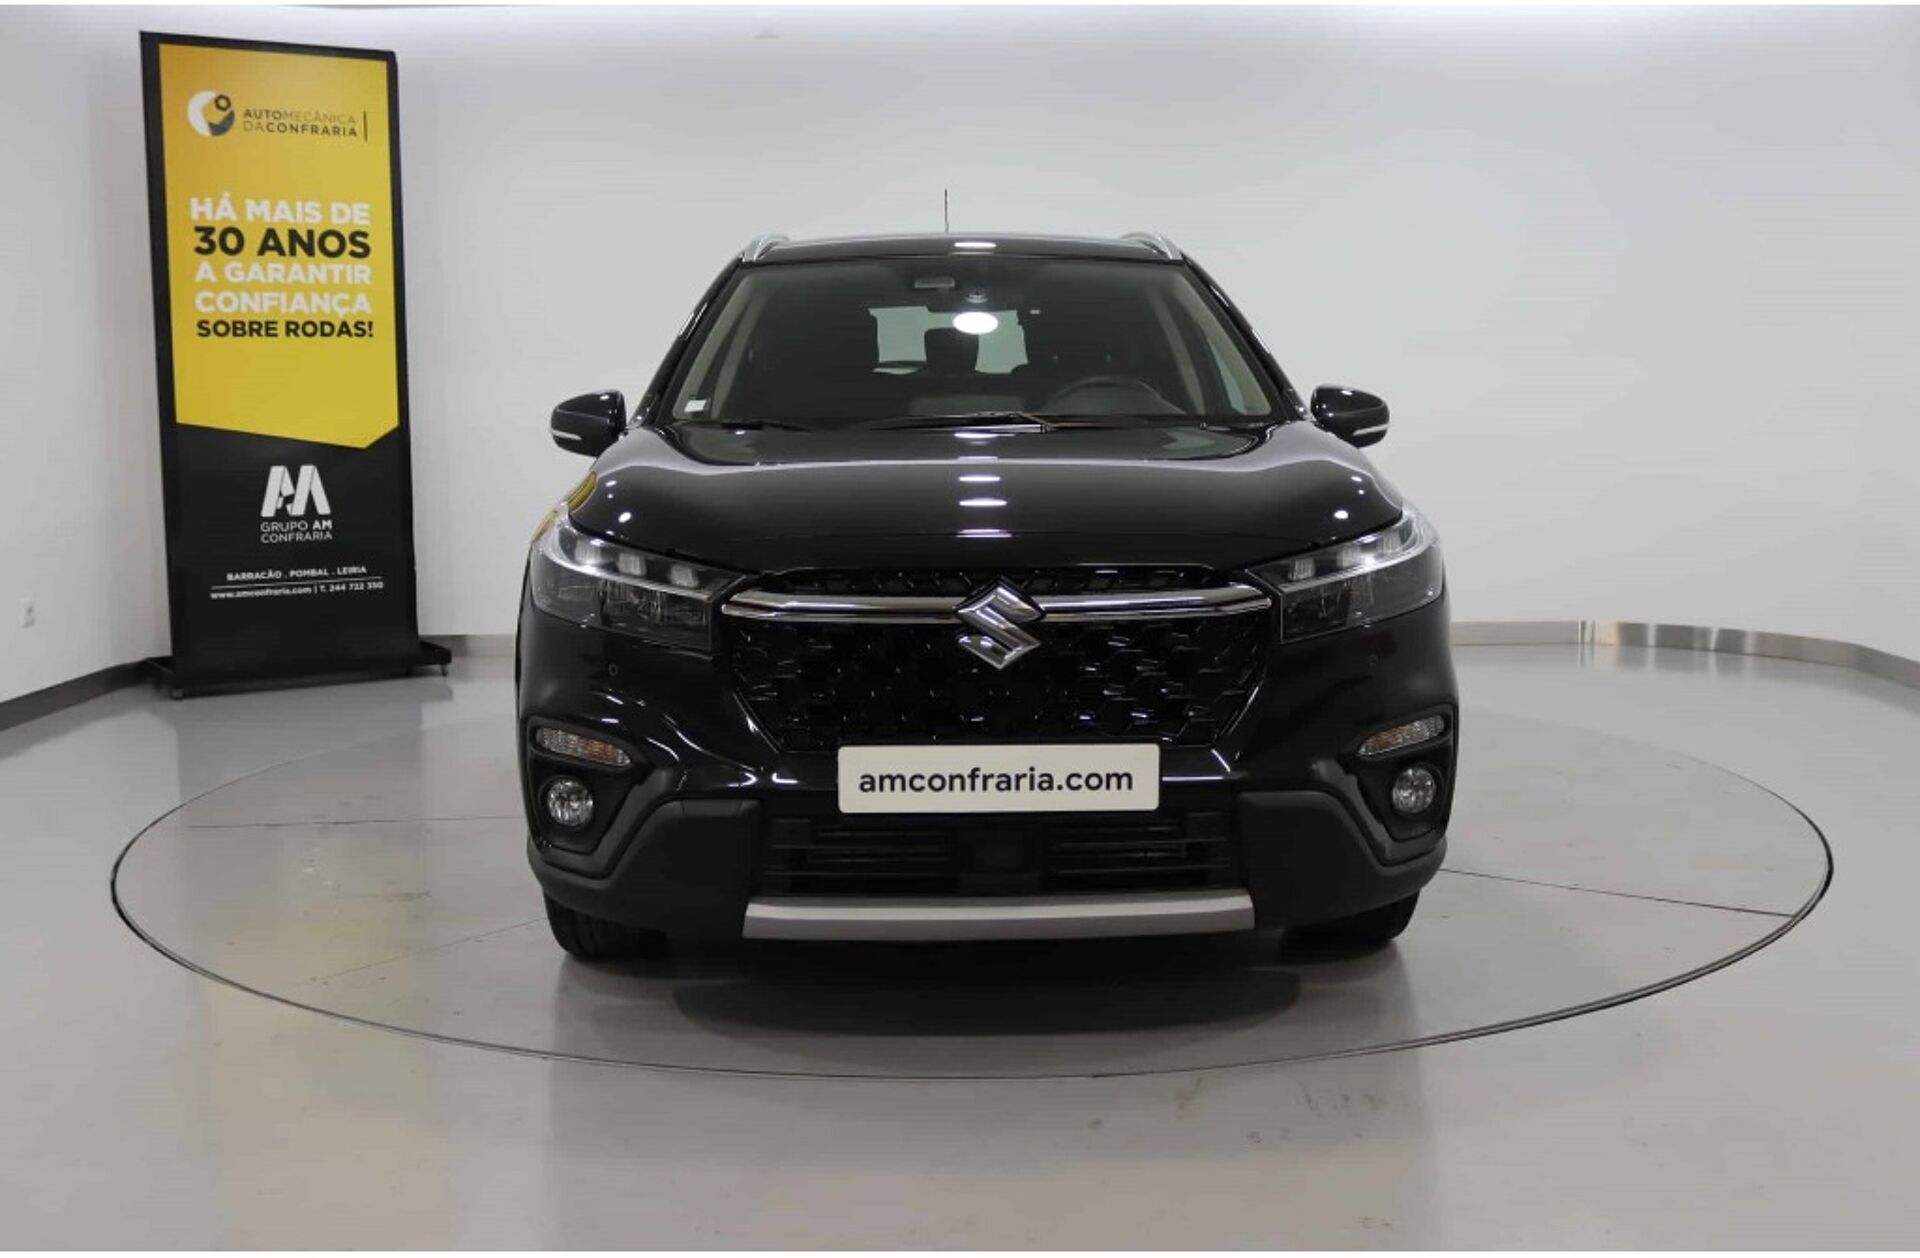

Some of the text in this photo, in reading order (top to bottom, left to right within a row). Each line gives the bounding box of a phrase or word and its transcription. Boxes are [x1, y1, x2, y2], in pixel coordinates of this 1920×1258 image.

[190, 192, 371, 225] HÁ MAIS DE
[194, 226, 371, 259] 30 ANOS
[195, 262, 372, 285] A GARANTIR
[194, 290, 372, 318] CONFIANÇA
[197, 319, 374, 338] SOBRE RODAS!
[260, 519, 333, 533] GRUPO AM
[260, 531, 333, 544] CONFRARIA
[226, 565, 367, 582] BARRACÃO POMBAL LEIRIA
[210, 586, 312, 600] www.amconfraria.com
[858, 766, 1134, 793] amconfraria.com
